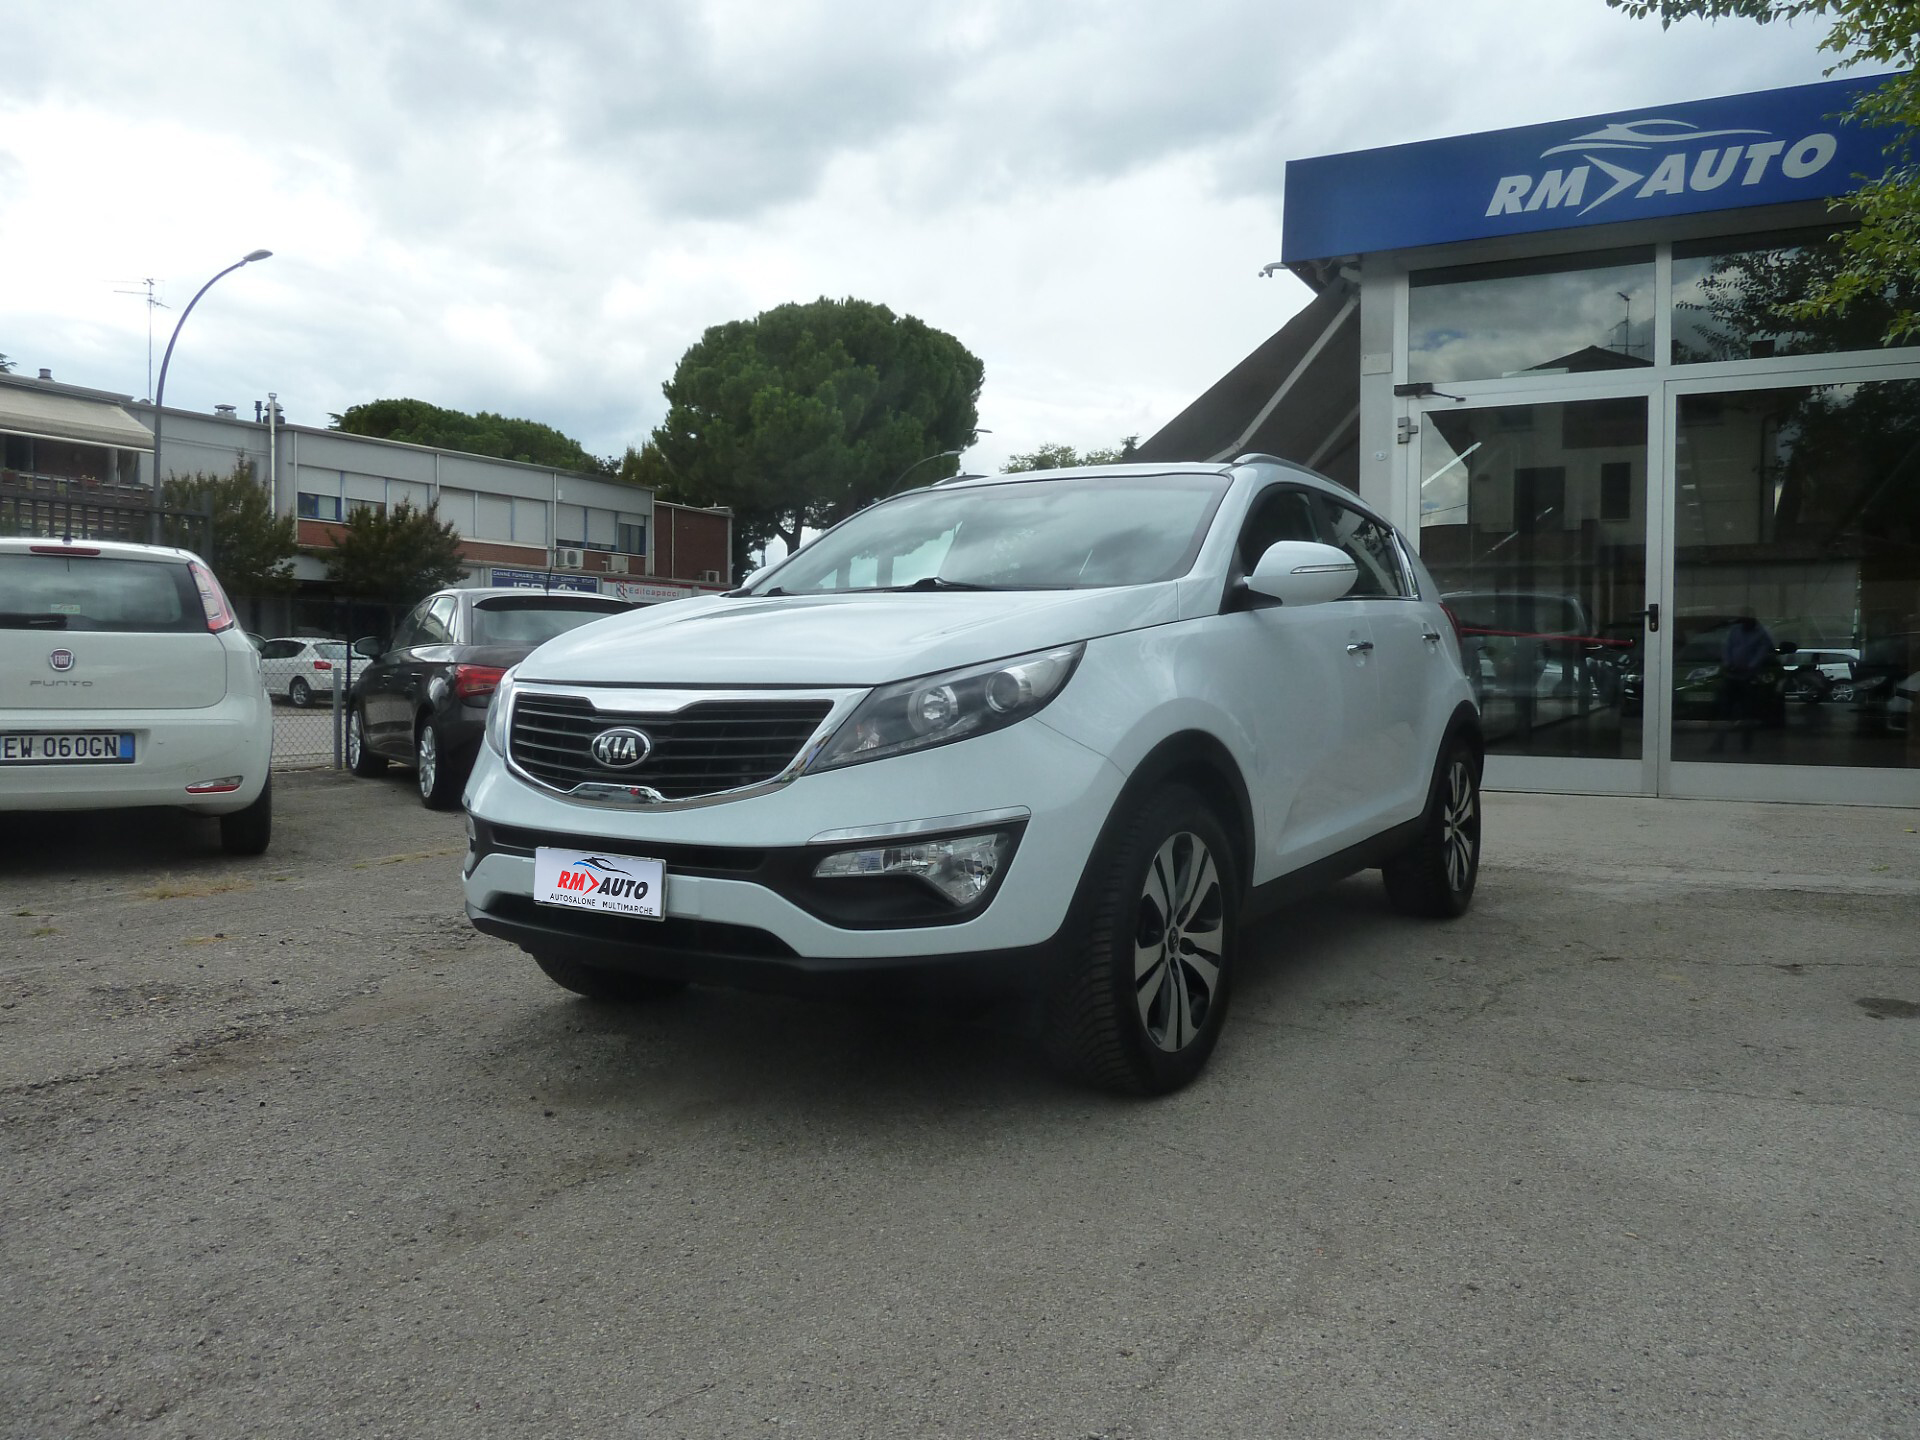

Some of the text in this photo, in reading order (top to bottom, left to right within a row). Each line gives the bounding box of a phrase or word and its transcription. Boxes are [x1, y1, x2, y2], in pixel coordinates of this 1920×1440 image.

[1485, 132, 1838, 217] RM AUTO
[54, 654, 69, 665] FIAT
[4, 736, 117, 759] EW 060GN
[598, 736, 637, 763] KIA
[557, 870, 649, 900] RM AUTO
[549, 892, 653, 915] AUTOSALONE MULTIMARCHE
